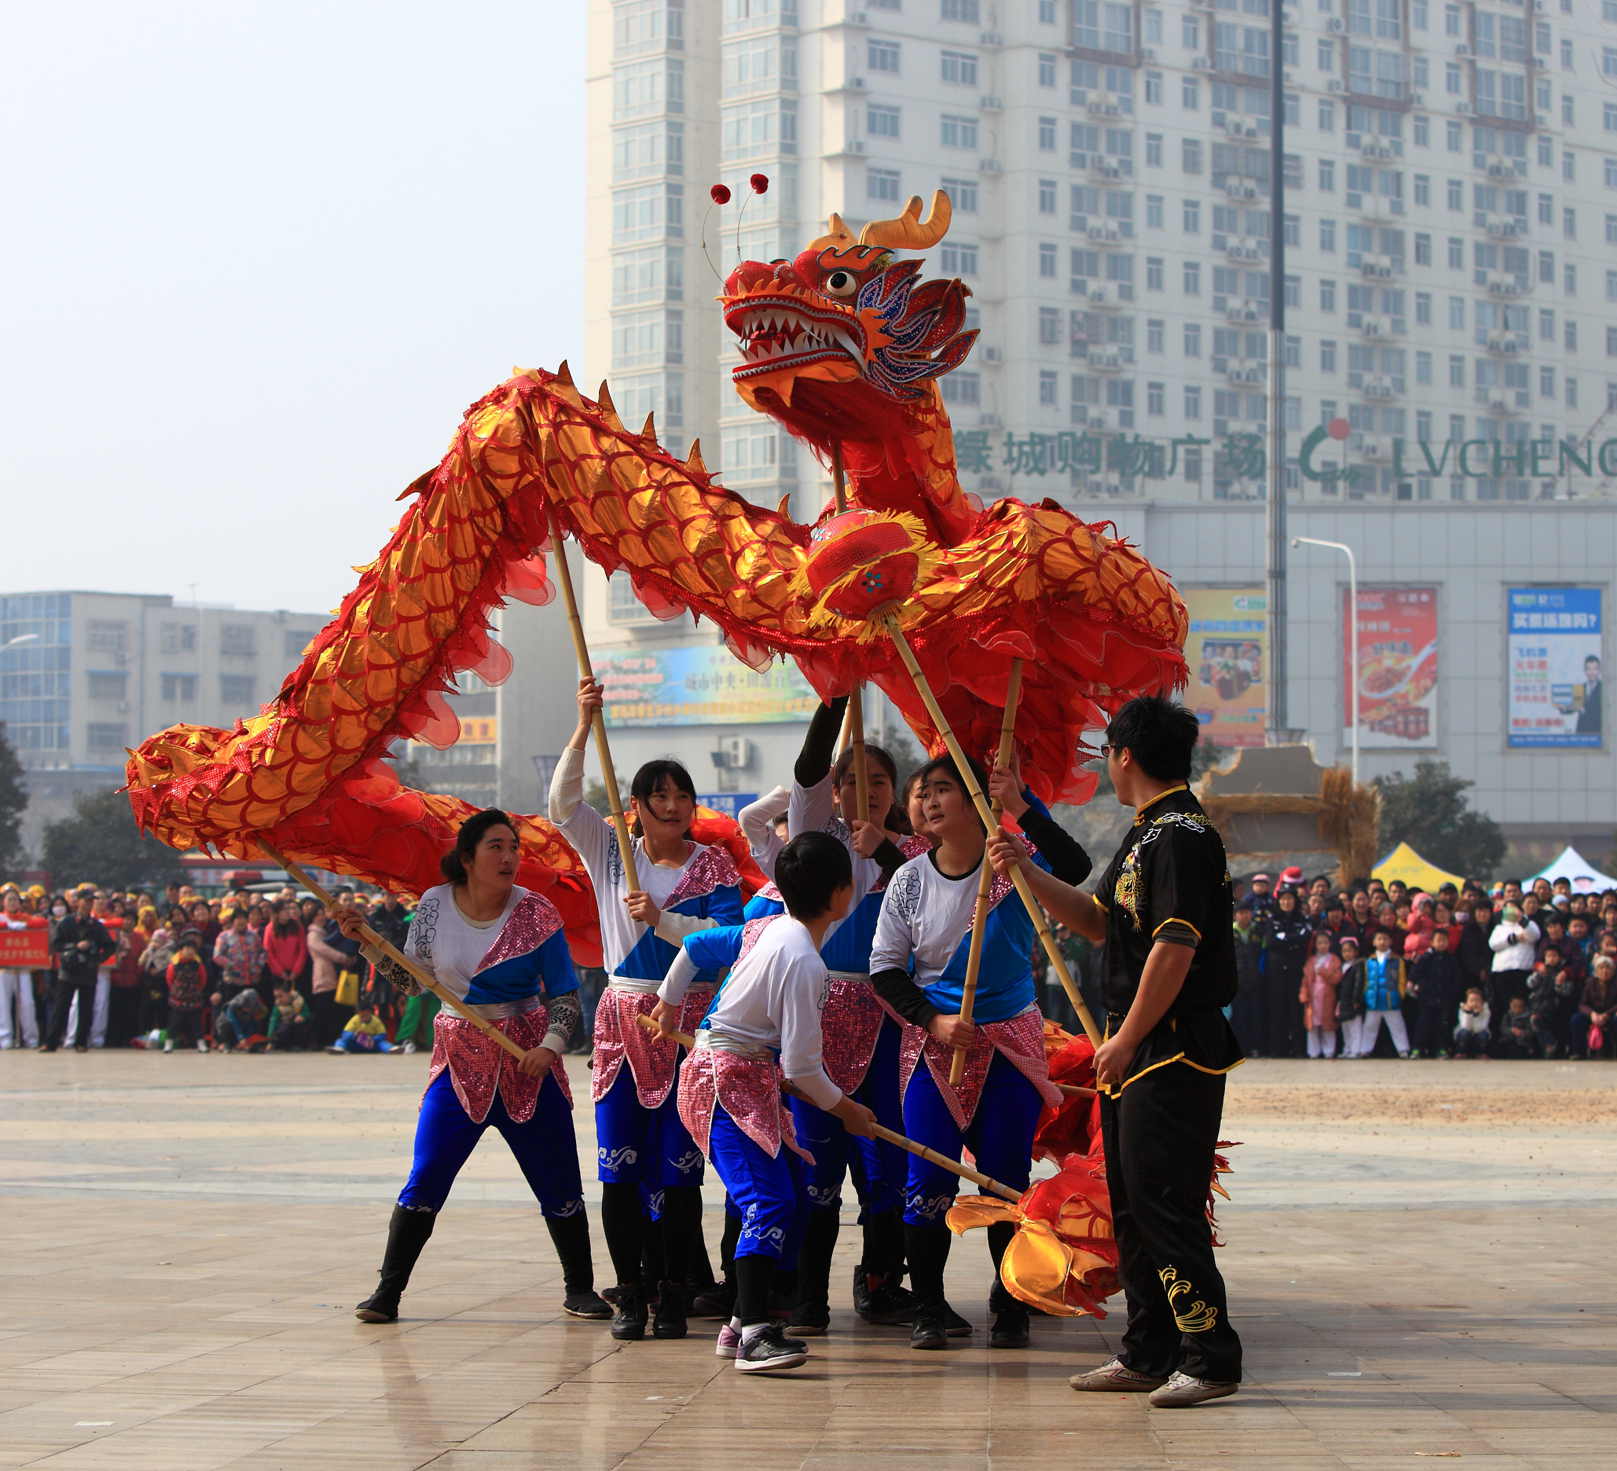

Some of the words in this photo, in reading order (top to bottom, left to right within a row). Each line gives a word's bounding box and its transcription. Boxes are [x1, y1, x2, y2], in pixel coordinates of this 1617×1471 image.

[954, 430, 1266, 477] 绿城购物广场
